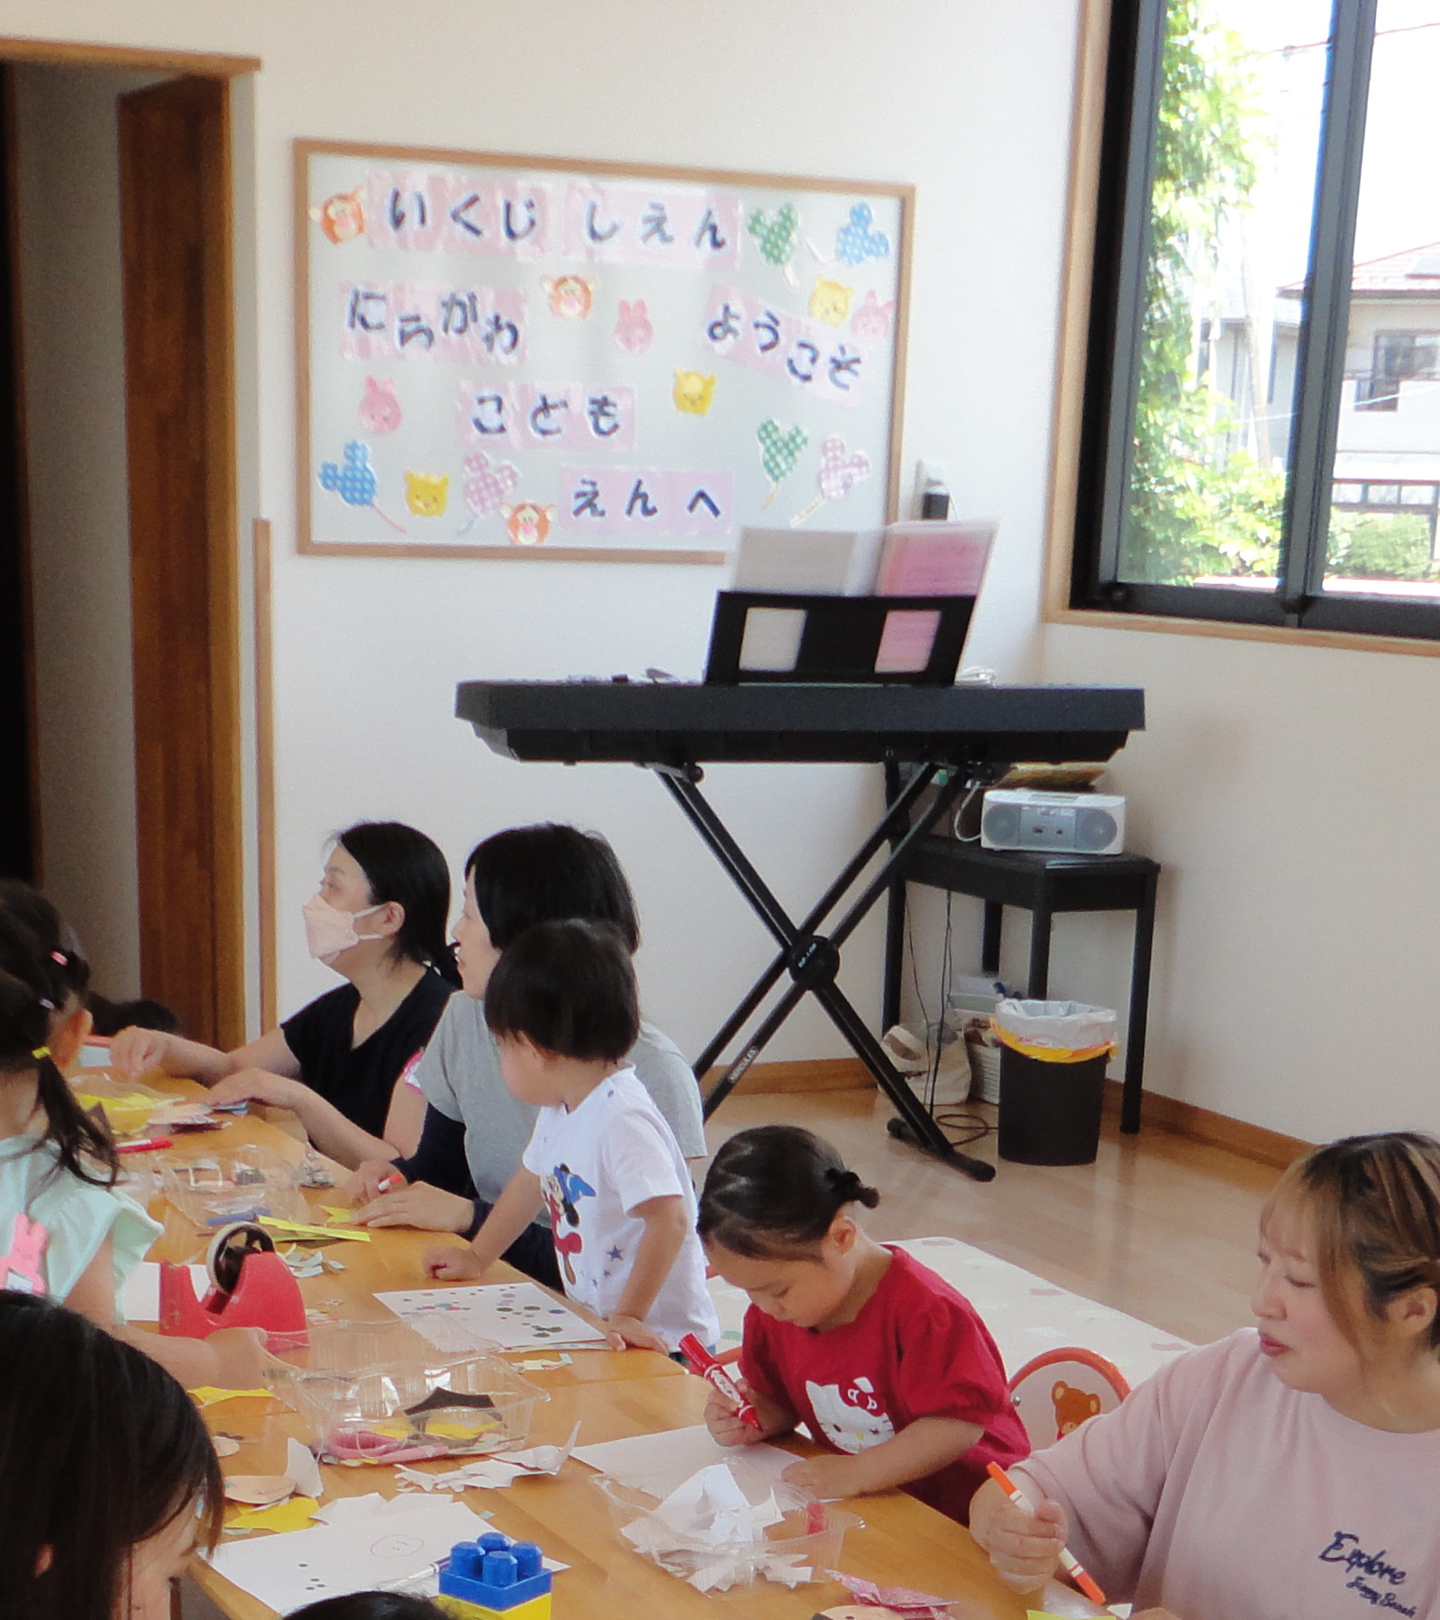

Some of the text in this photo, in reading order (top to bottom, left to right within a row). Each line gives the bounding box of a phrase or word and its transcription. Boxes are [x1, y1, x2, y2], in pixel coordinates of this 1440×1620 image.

[387, 186, 726, 250] いくじ しえん
[707, 302, 862, 391] ようこそ
[572, 478, 721, 520] えんへ
